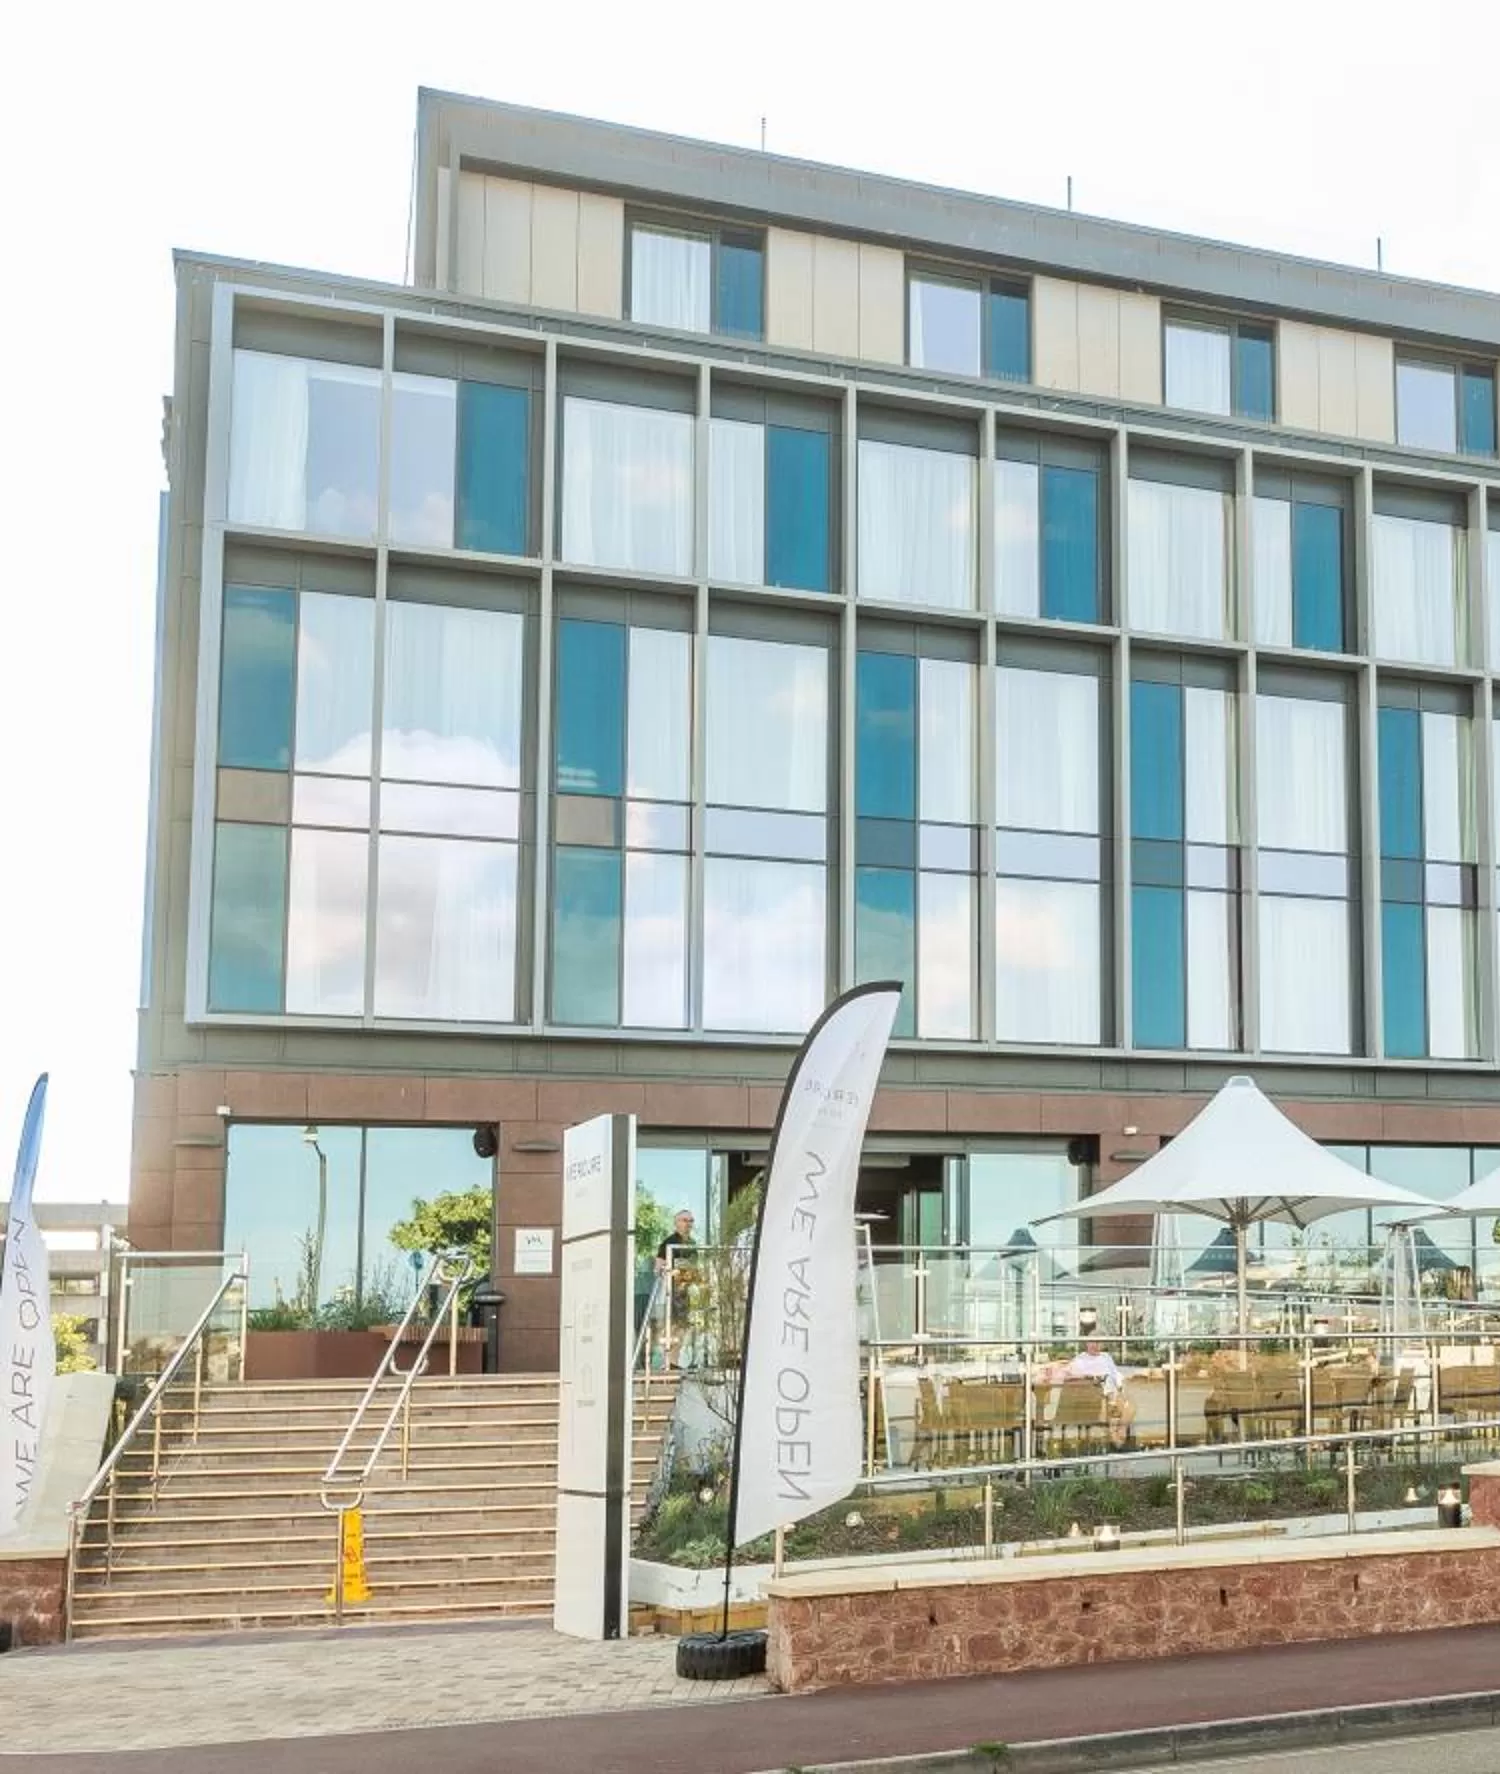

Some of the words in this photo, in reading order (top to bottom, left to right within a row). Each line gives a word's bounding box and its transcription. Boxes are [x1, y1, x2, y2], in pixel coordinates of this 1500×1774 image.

[12, 1217, 41, 1331] OPEN
[11, 1343, 36, 1430] ARE
[15, 1439, 37, 1508] WE
